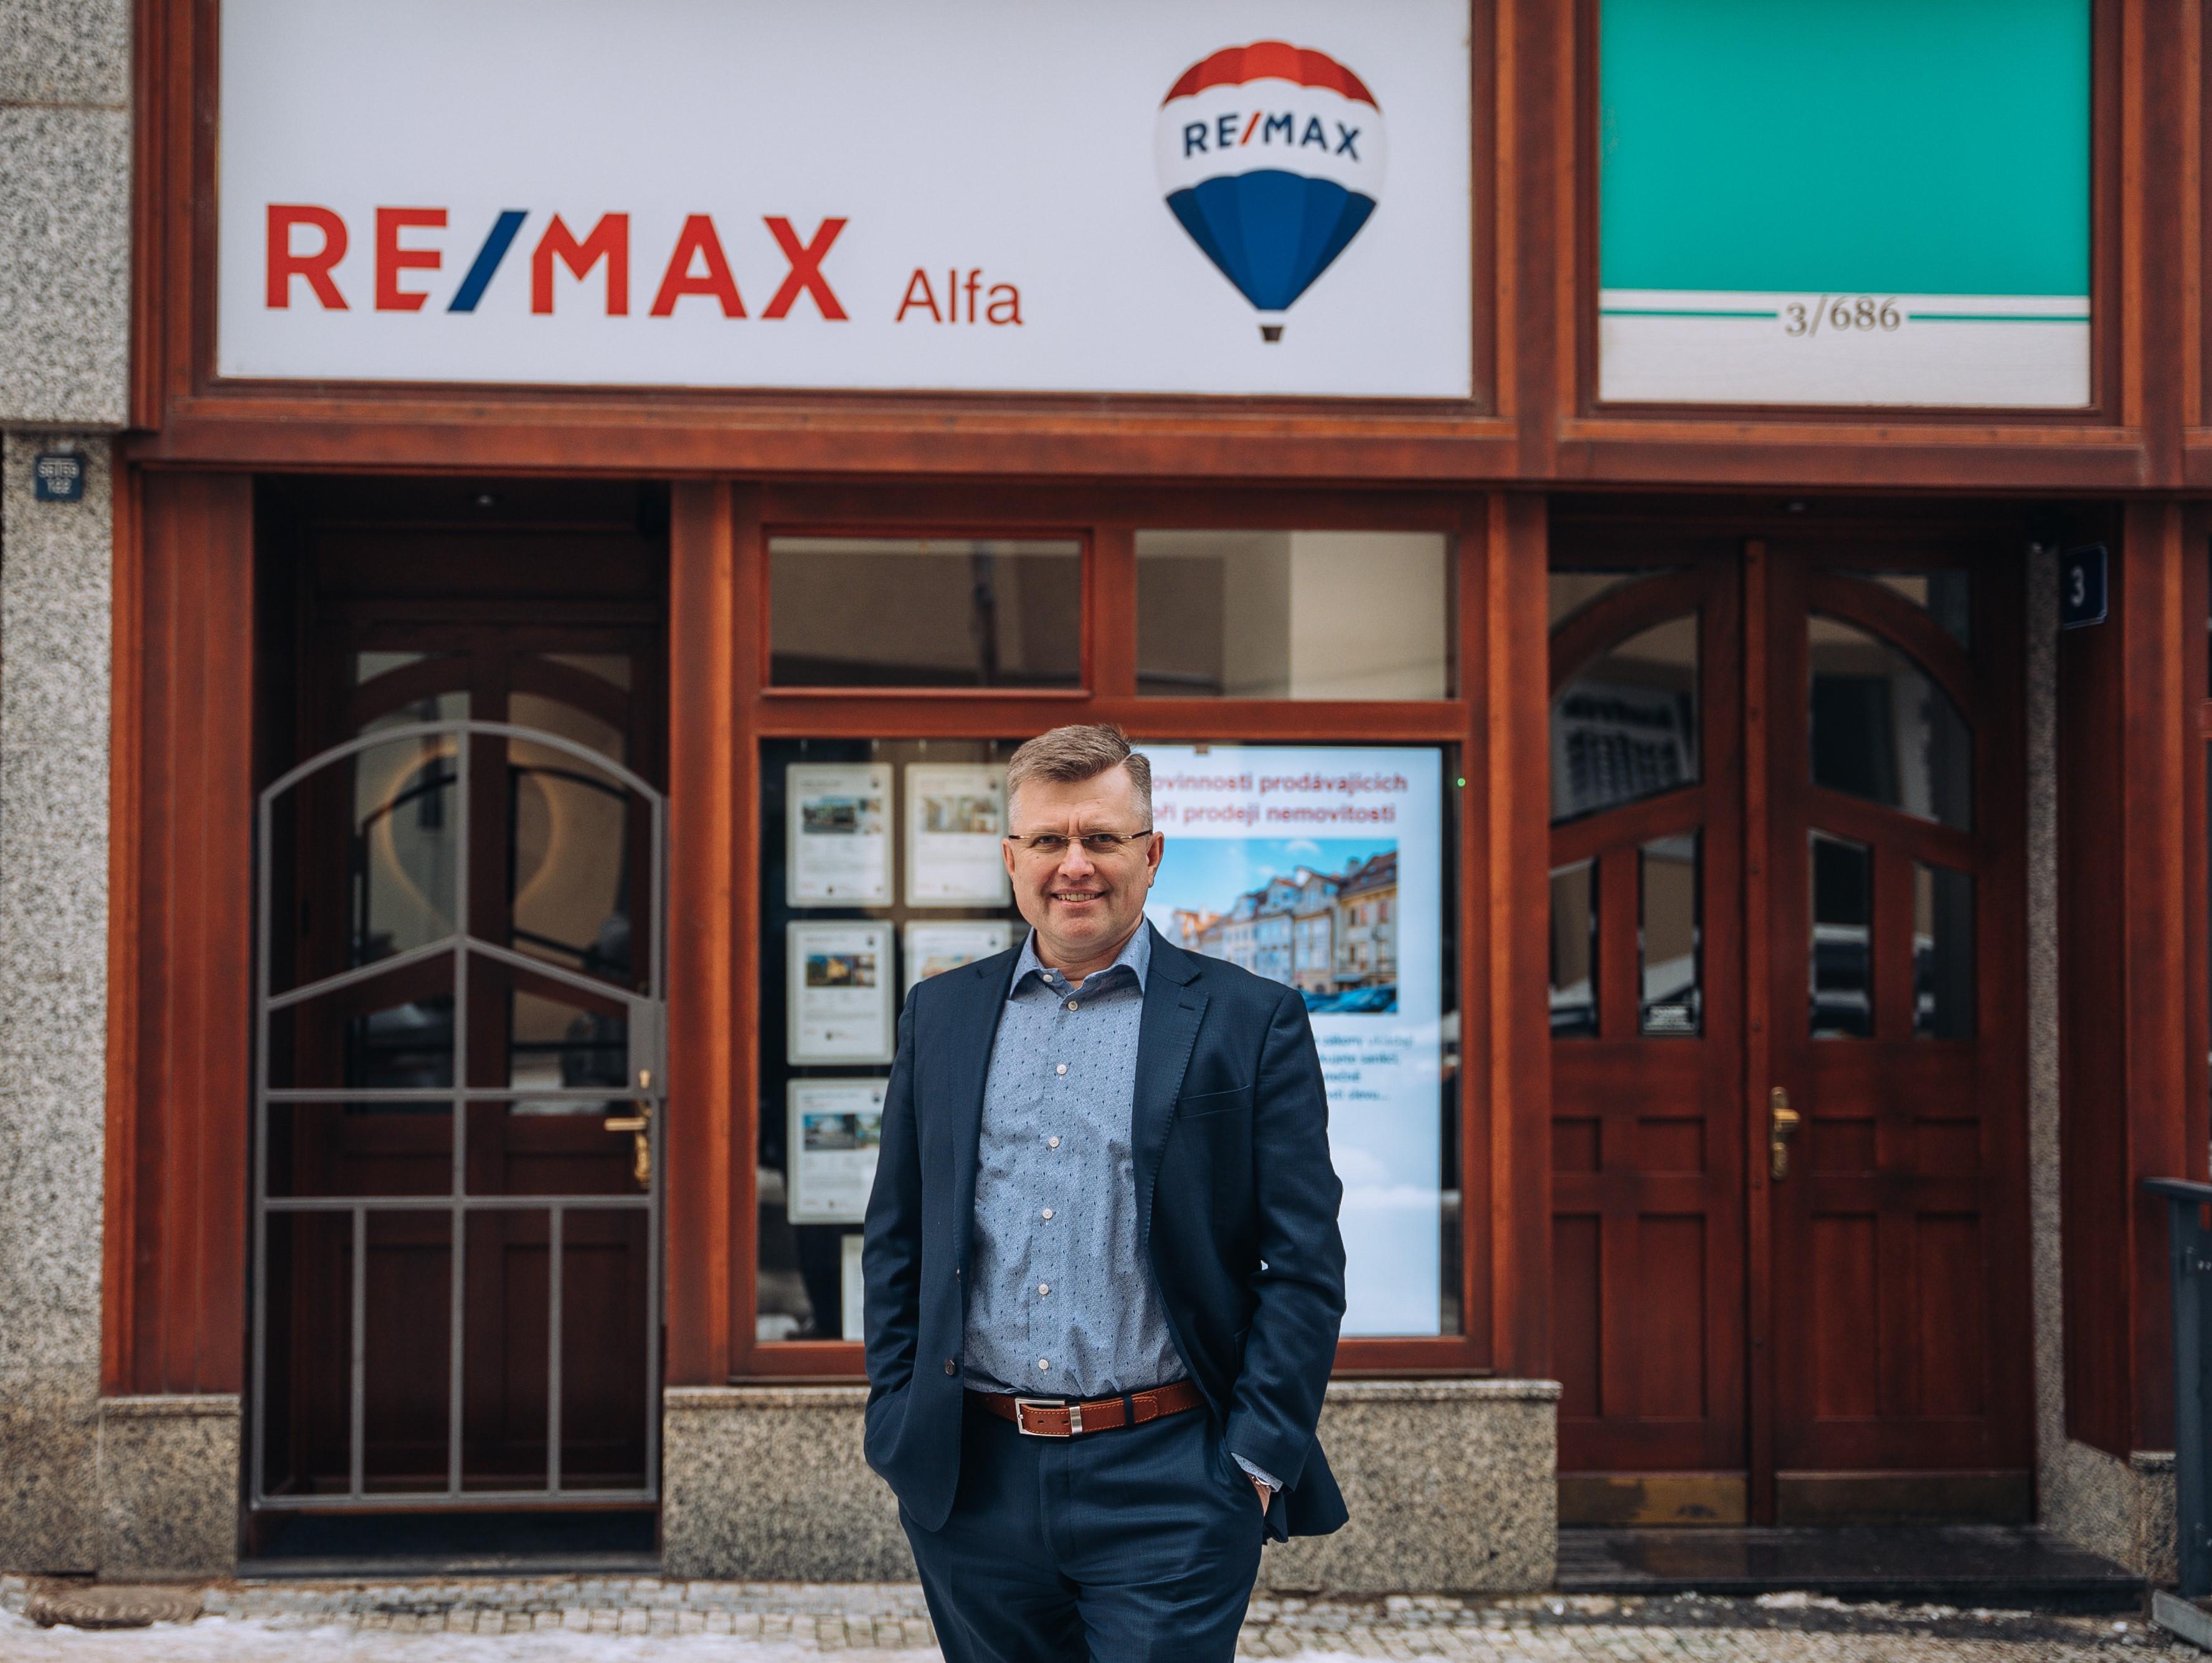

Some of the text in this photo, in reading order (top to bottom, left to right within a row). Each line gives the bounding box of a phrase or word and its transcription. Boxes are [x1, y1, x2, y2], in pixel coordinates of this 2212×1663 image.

[1183, 110, 1361, 162] RE/MAX
[265, 203, 1024, 326] RE/MAX Alfa
[1784, 293, 1901, 338] 3/686
[2070, 565, 2085, 607] 3
[1151, 772, 1254, 792] ovinnosti
[1183, 803, 1260, 827] prodeji
[1265, 803, 1397, 823] nemovitosti
